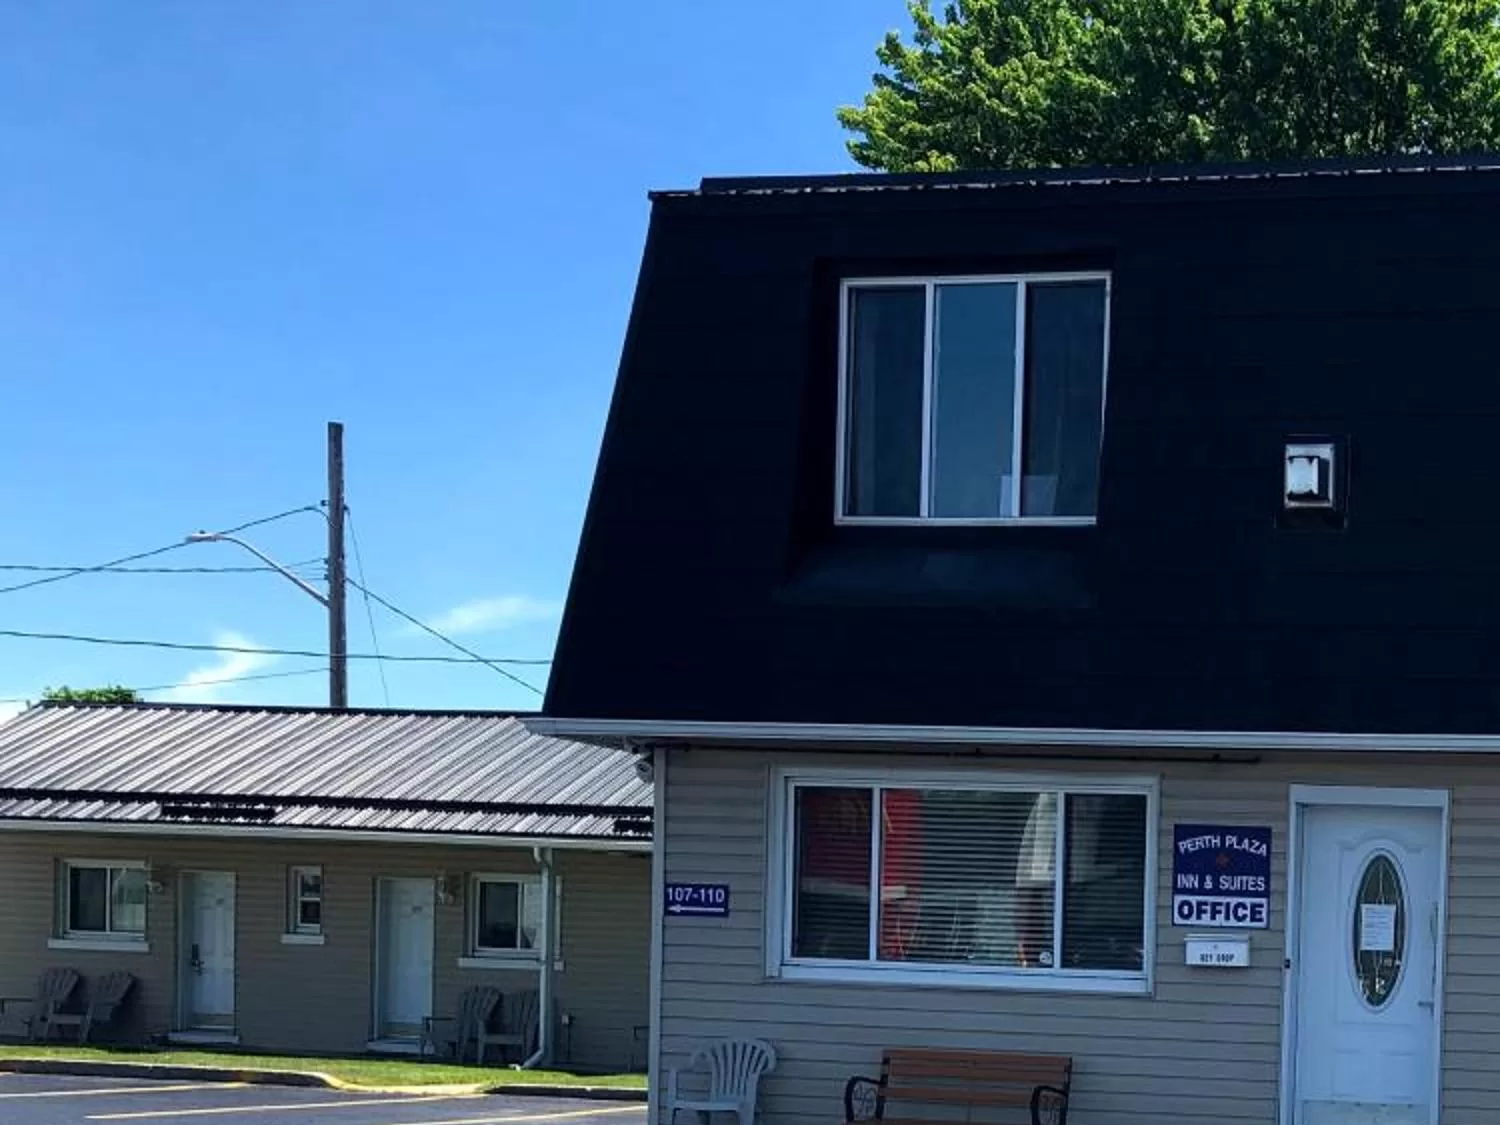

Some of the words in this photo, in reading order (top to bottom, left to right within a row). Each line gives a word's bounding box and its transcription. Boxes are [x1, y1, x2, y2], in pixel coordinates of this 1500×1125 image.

[1178, 835, 1220, 854] PERTH
[1225, 835, 1266, 856] PLAZA
[1177, 873, 1199, 889] INN
[1204, 874, 1213, 890] &
[1219, 875, 1265, 891] SUITES
[667, 887, 725, 903] 107-110
[1178, 900, 1264, 922] OFFICE
